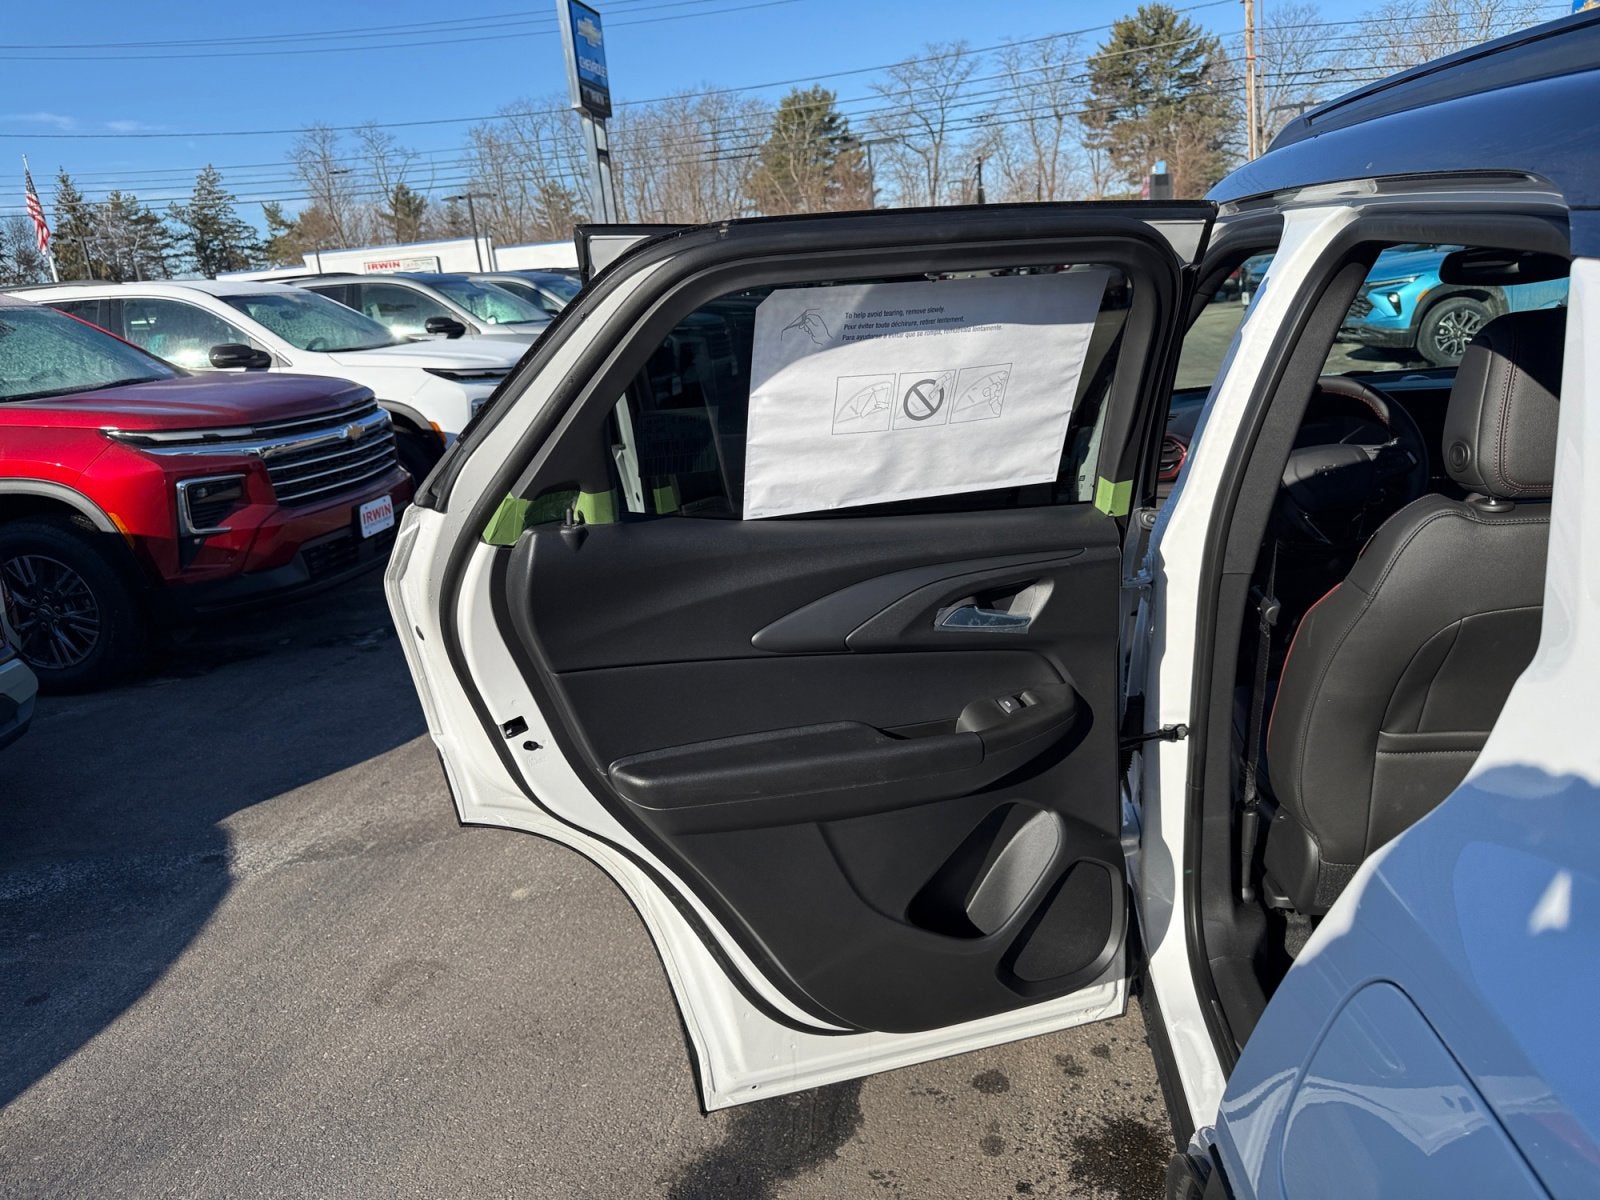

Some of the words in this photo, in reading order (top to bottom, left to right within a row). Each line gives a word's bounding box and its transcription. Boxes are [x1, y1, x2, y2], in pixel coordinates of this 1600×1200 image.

[367, 261, 400, 270] IRWIN
[853, 311, 867, 320] help
[867, 310, 883, 318] avoid
[905, 331, 916, 339] que
[363, 503, 391, 525] IRWIN
